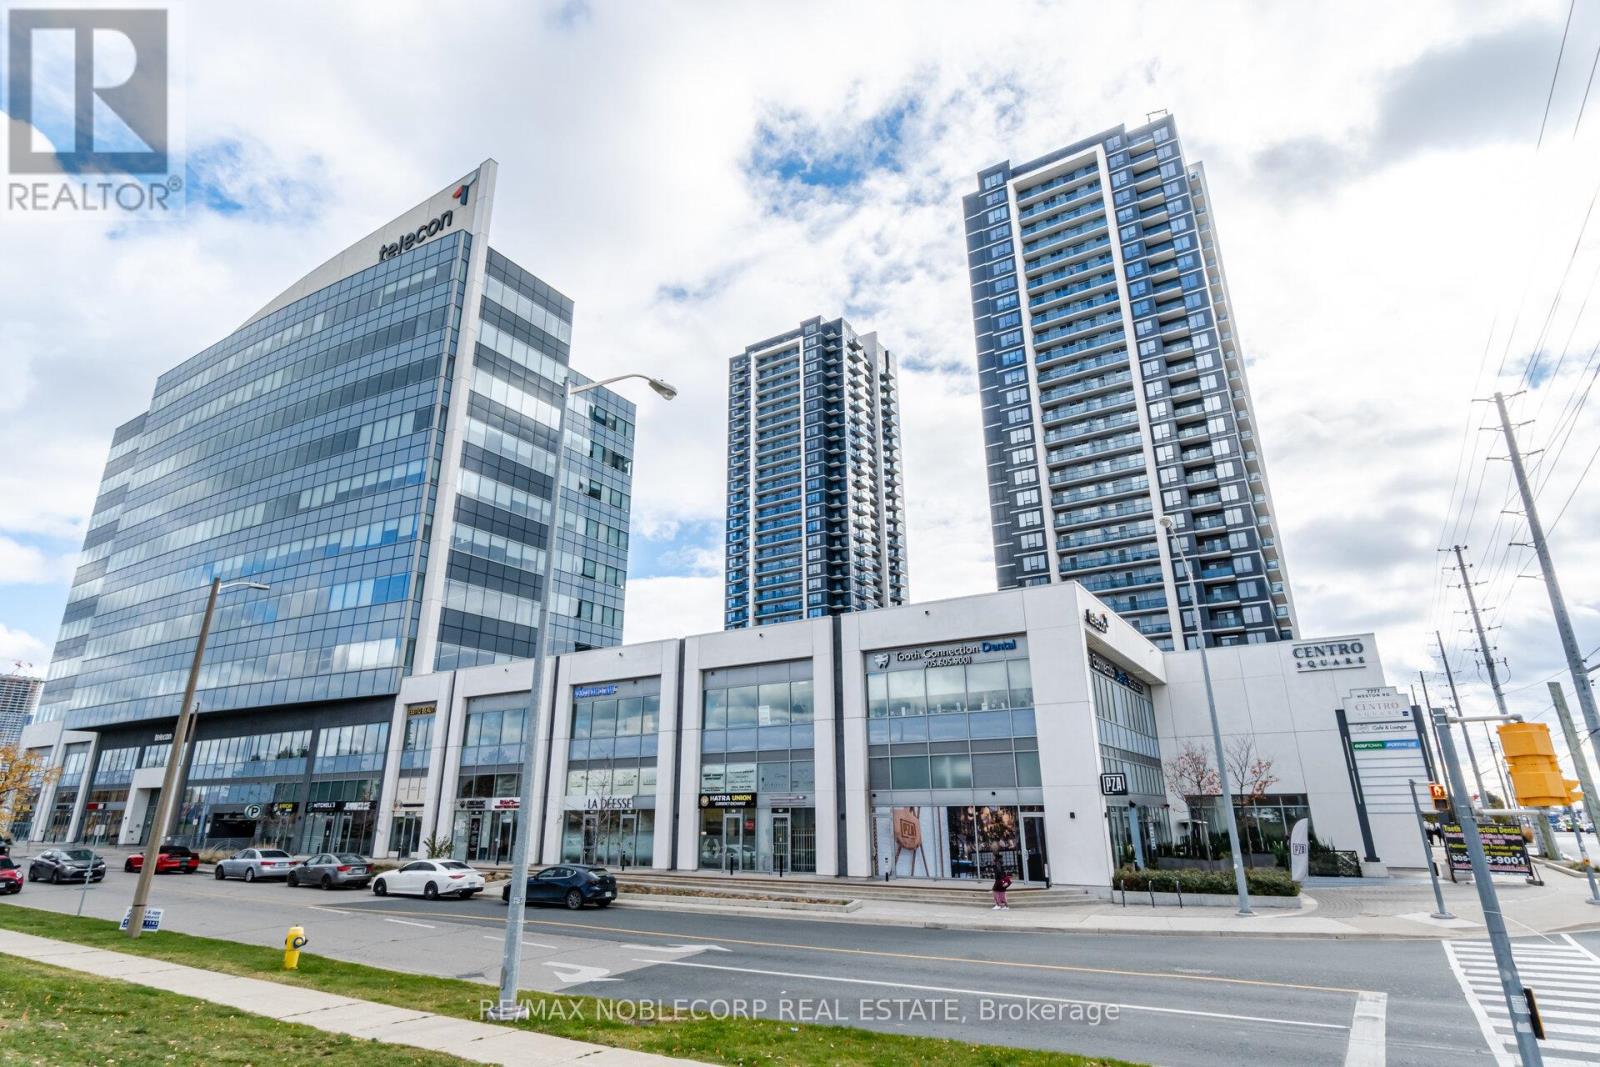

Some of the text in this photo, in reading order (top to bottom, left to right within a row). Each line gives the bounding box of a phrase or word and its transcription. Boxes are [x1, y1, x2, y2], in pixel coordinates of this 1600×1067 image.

[379, 209, 453, 261] telecon
[895, 639, 1016, 661] Tooth Connection Dental
[1292, 642, 1364, 659] CENTRO
[1296, 656, 1365, 669] SQUARE
[1355, 702, 1399, 712] CENTRO
[1105, 777, 1122, 792] PZA
[587, 798, 598, 809] LA
